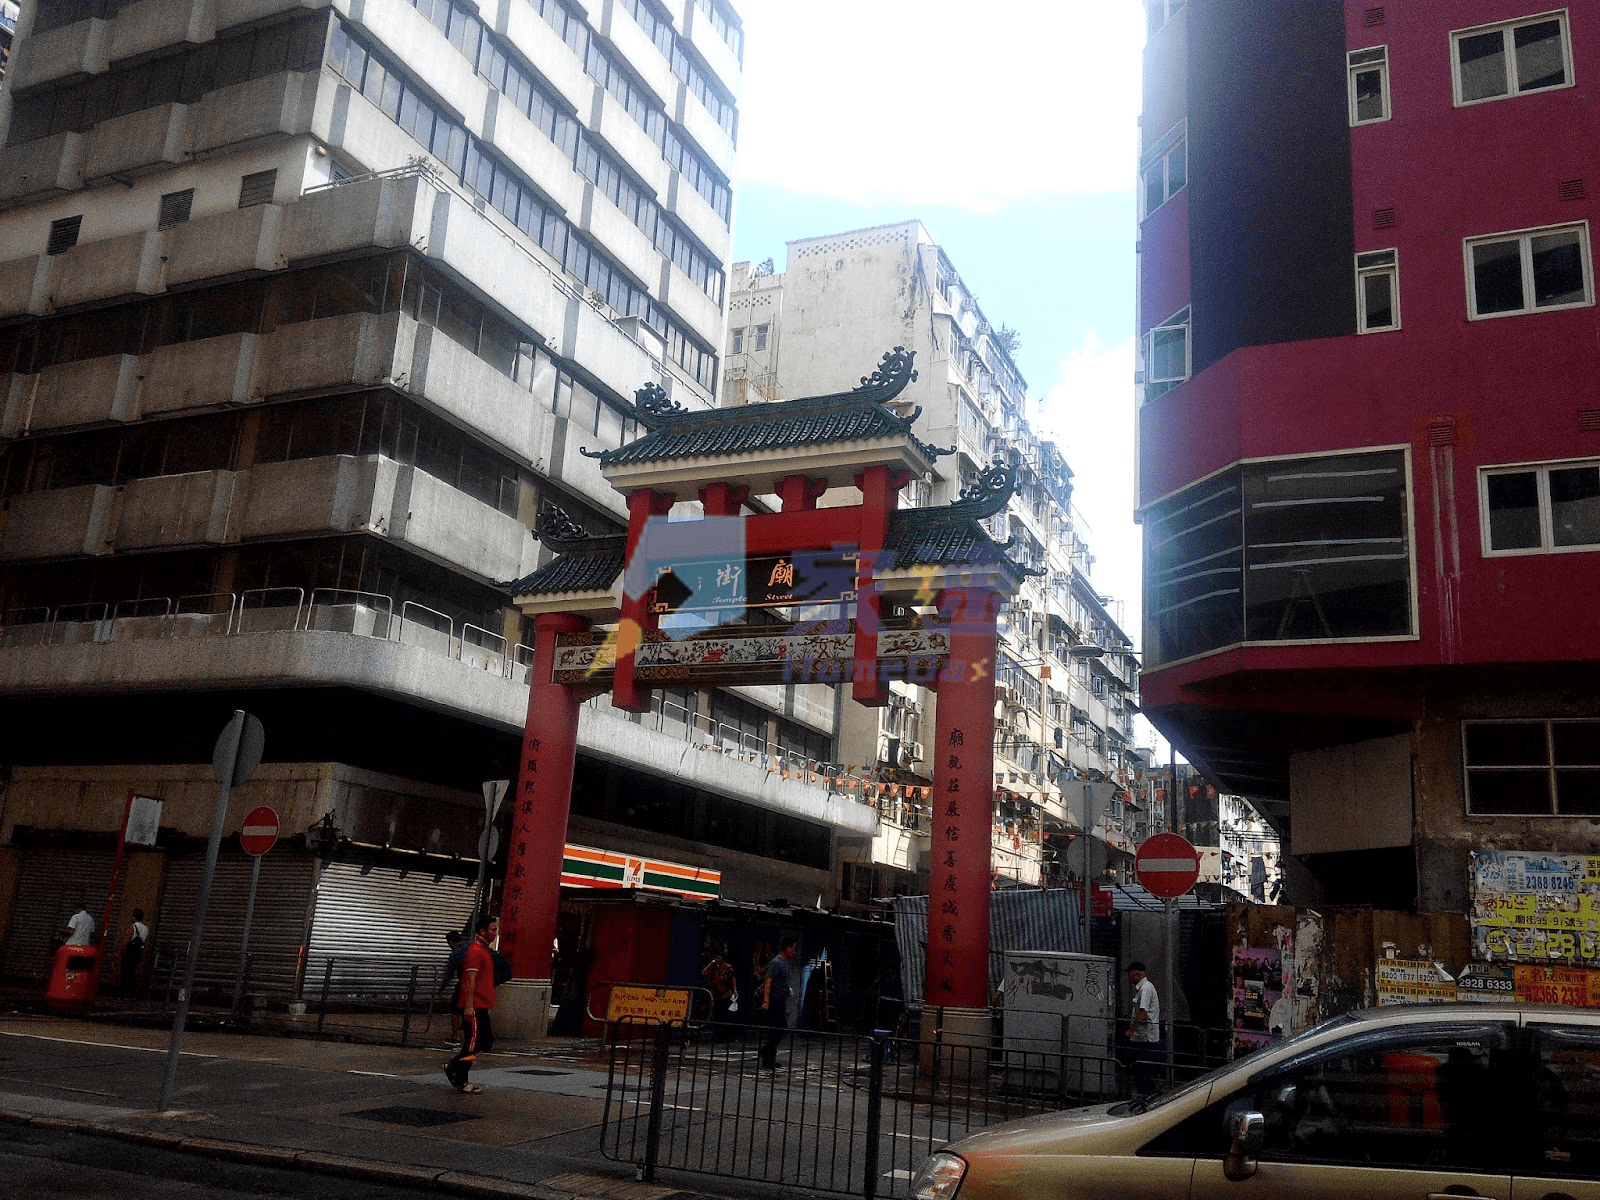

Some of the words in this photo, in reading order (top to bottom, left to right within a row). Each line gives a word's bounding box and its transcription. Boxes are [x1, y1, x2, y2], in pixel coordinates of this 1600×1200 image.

[765, 593, 793, 601] Street
[1459, 979, 1484, 989] 2928
[1487, 980, 1513, 991] 6333
